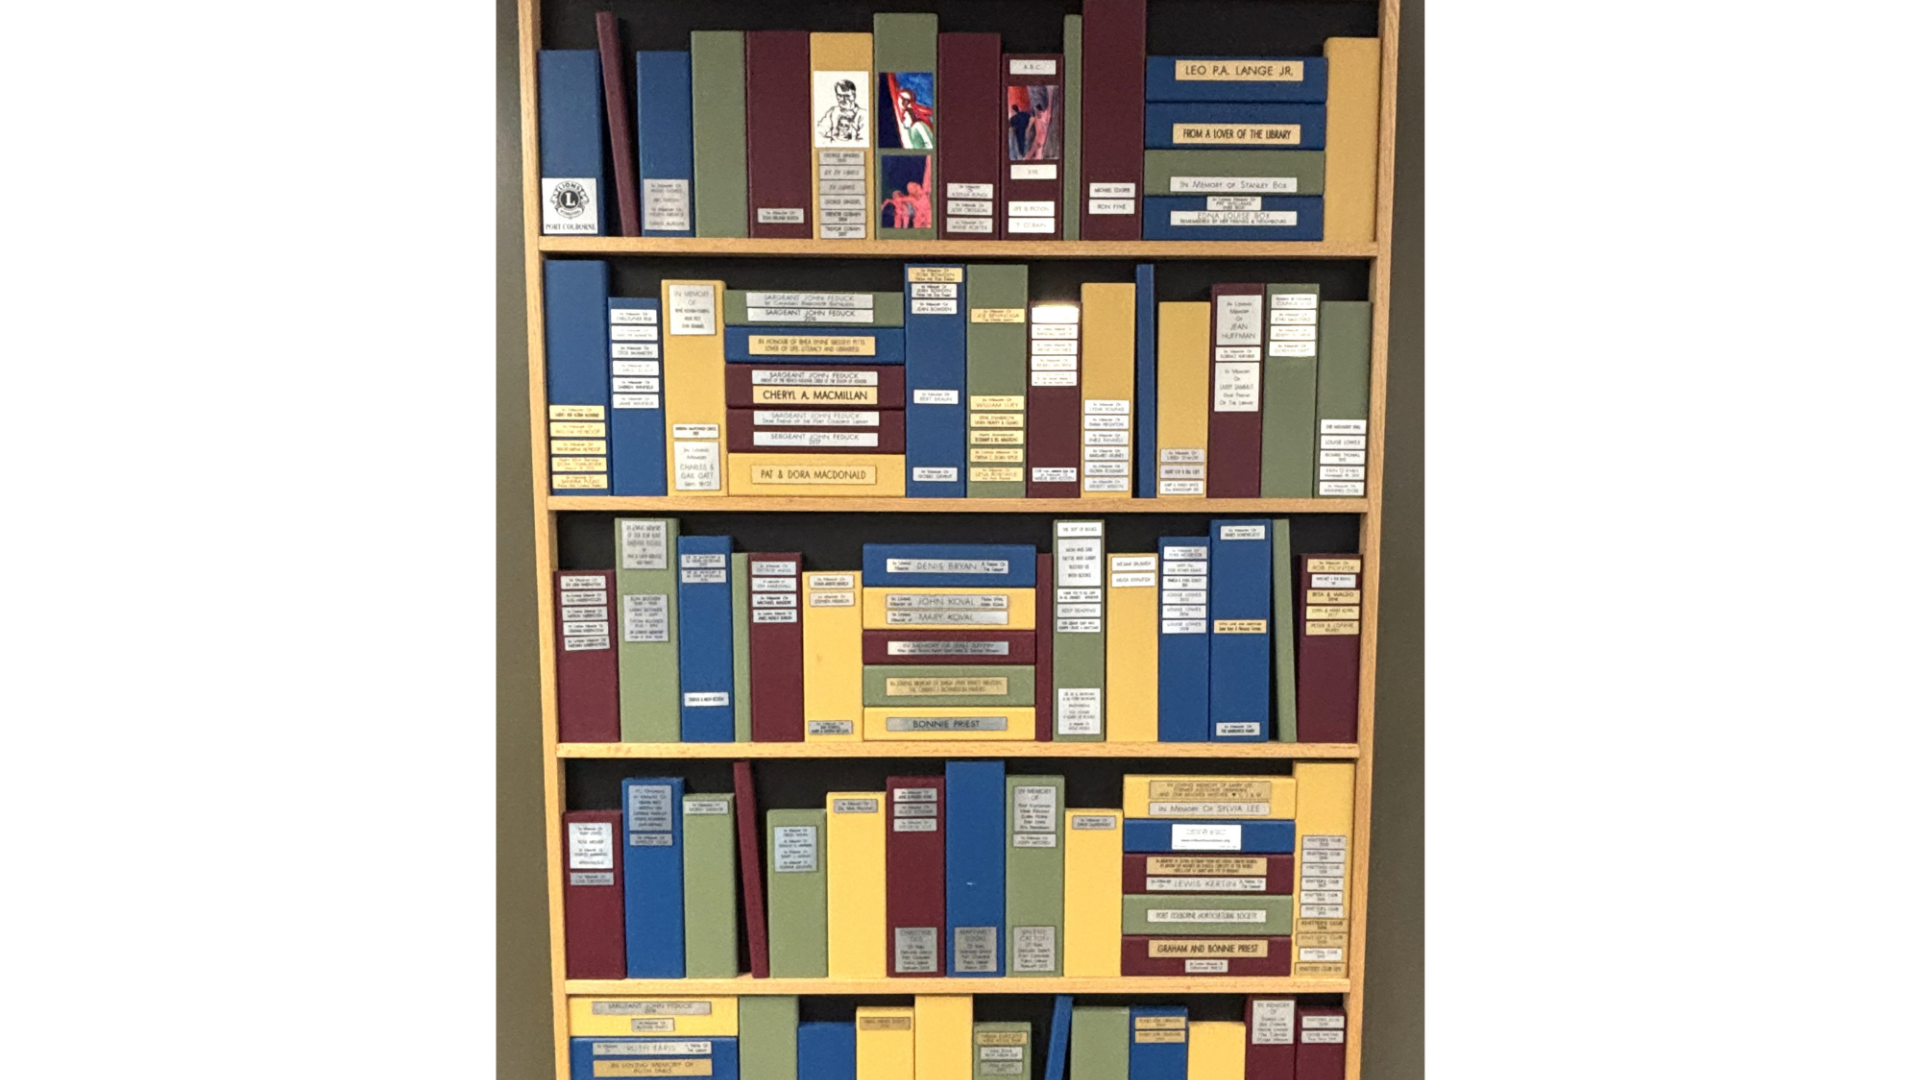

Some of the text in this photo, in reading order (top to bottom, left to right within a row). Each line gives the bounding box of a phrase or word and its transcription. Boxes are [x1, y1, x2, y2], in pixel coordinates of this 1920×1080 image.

[1185, 66, 1293, 76] LEO P.A. LANGE JR.
[1183, 129, 1291, 139] FROM A LOVER OF THE LIBRARY
[558, 180, 582, 192] LIONS
[566, 192, 576, 206] L
[763, 390, 868, 400] CHERYL A. MACMILLAN
[761, 471, 867, 479] PAT & DORA MACDONALD
[917, 562, 943, 570] DENIS
[919, 613, 973, 622] MARY KOVAL
[1158, 944, 1258, 953] GRAHAM AND BONNIE PRIEST
